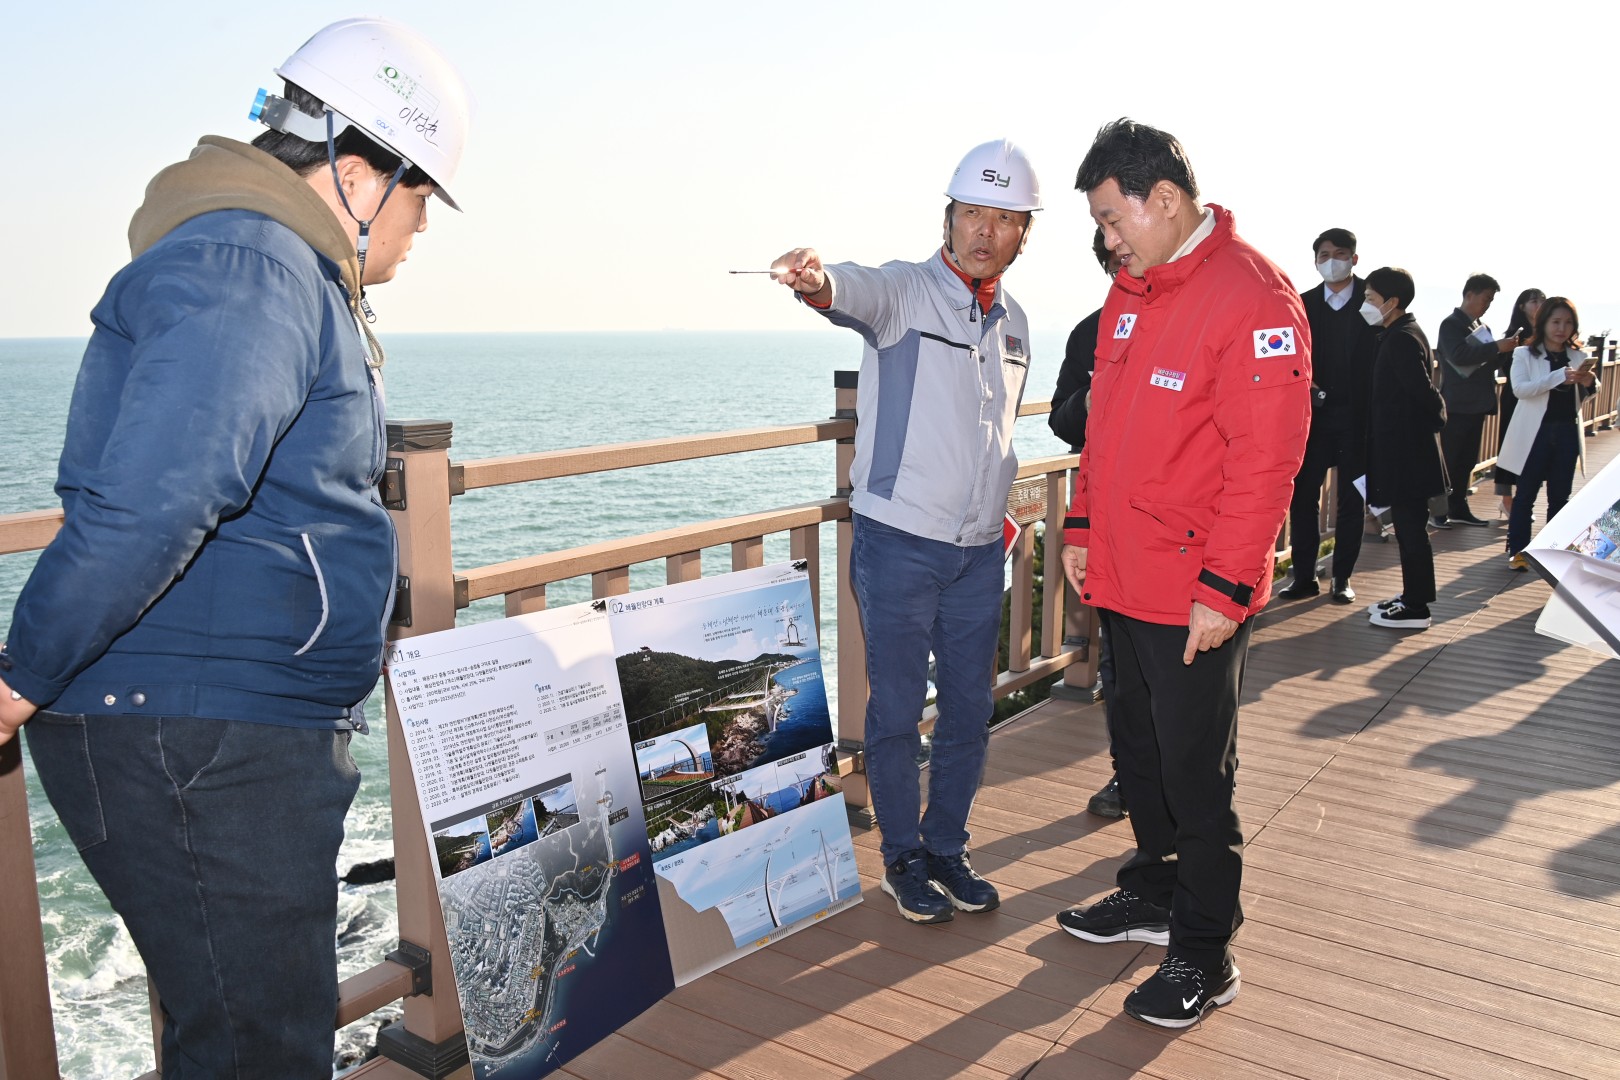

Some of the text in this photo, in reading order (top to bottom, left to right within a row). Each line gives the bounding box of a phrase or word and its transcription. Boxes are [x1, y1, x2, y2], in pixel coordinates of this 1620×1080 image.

[612, 602, 623, 614] 02
[390, 648, 421, 663] 01 개요
